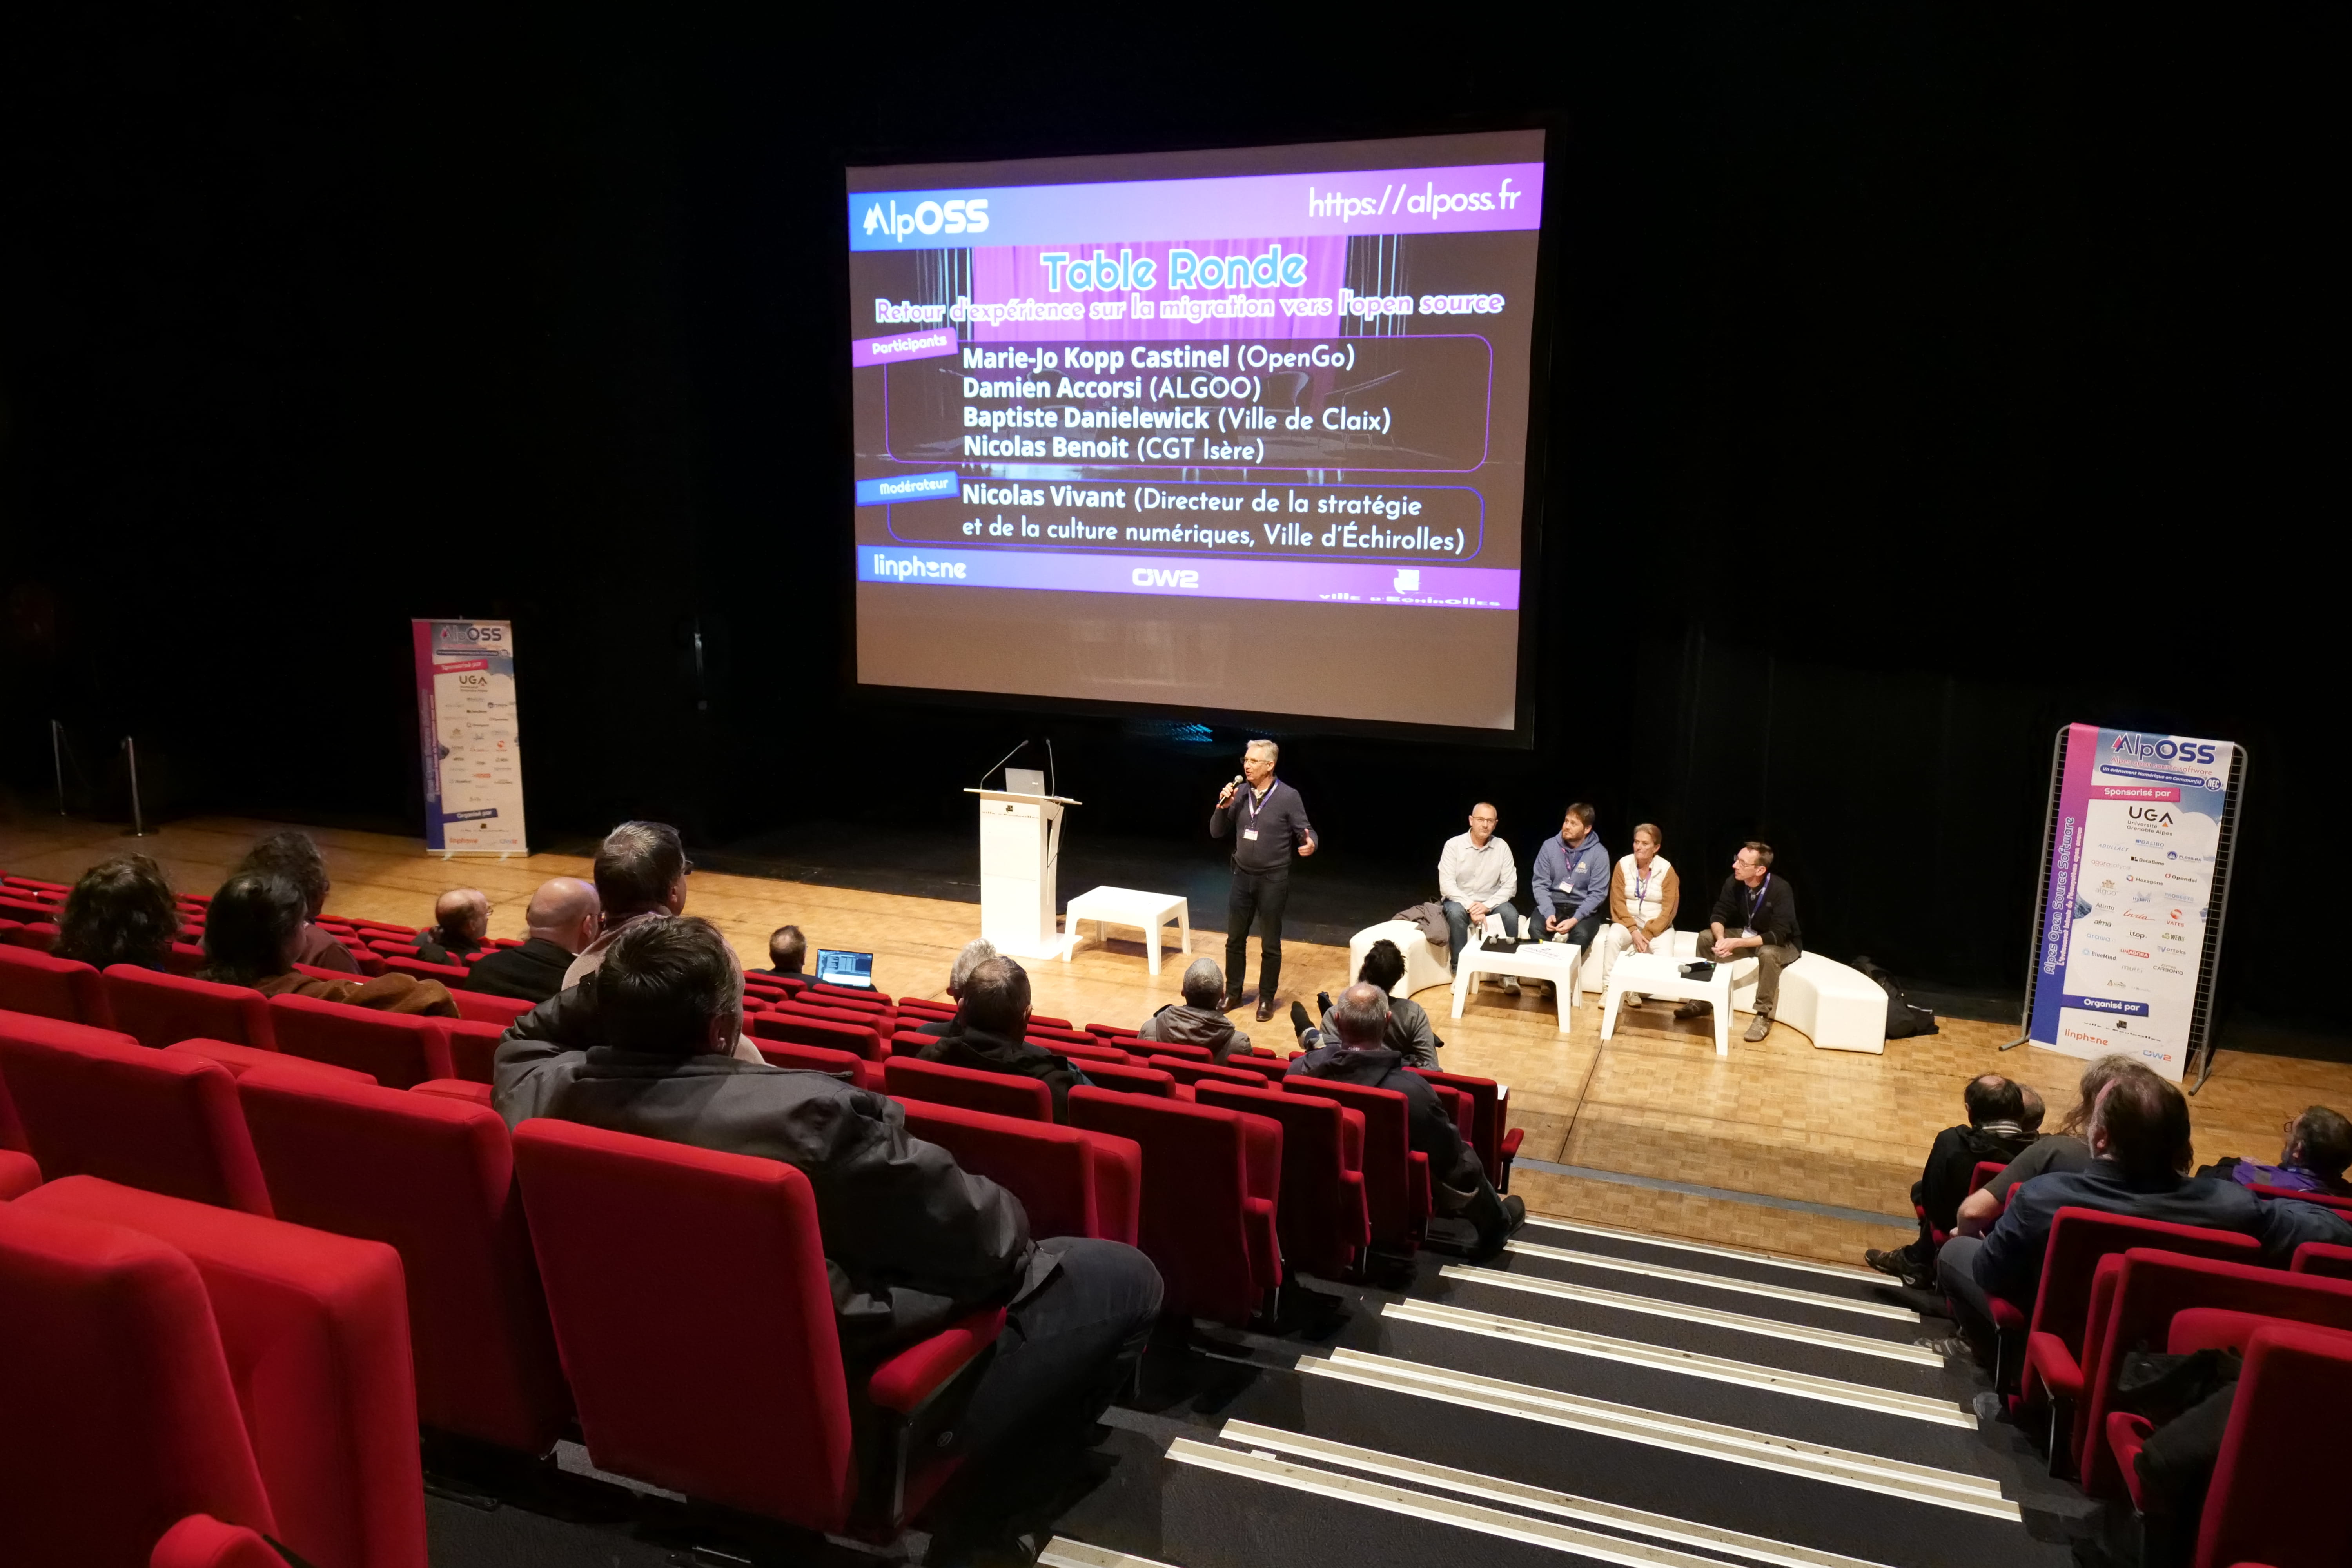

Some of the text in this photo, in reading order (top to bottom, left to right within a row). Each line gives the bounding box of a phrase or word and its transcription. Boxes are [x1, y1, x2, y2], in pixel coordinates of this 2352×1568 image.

[1309, 178, 1521, 223] https://alposs.fr
[863, 199, 989, 243] AlpOSS
[1040, 244, 1307, 292] Table Ronde
[875, 288, 1505, 326] Retour d'expérience sur la migration vers l'open source
[872, 334, 947, 356] Participants
[963, 344, 1355, 374] Marie-Jo Kopp Castinel (OpenGo)
[963, 375, 1261, 403] Damien Accorsi (ALGOO)
[964, 406, 1391, 435] Baptiste Danielewick (Ville de Claix)
[964, 435, 1264, 465] Nicolas Benoit (CGT Isère)
[879, 478, 949, 495] Modérateur
[962, 483, 1422, 521] Nicolas Vivant (Directeur de la stratégie
[962, 514, 1465, 554] et de la culture numériques, Ville d'Échirolles)
[873, 554, 967, 581] linphone
[1132, 568, 1199, 588] OW2
[459, 675, 487, 685] UGA
[2111, 733, 2216, 764] AlpOSS
[2111, 756, 2131, 765] Alpes
[2179, 766, 2213, 775] software
[2104, 788, 2152, 797] Sponsorisé
[2127, 820, 2158, 828] Université
[2129, 806, 2173, 825] UGA
[2127, 825, 2155, 834] Grenoble
[2136, 877, 2163, 886] Hexagone
[2044, 817, 2074, 975] Alpes Open Source Software
[2094, 919, 2112, 927] alma
[2086, 933, 2111, 942] arawa
[2091, 951, 2116, 961] BlueMind
[2120, 949, 2149, 958] LINAGORA
[2084, 998, 2122, 1009] Organisé
[2065, 1028, 2108, 1046] linphone
[2143, 1049, 2172, 1062] OW2
